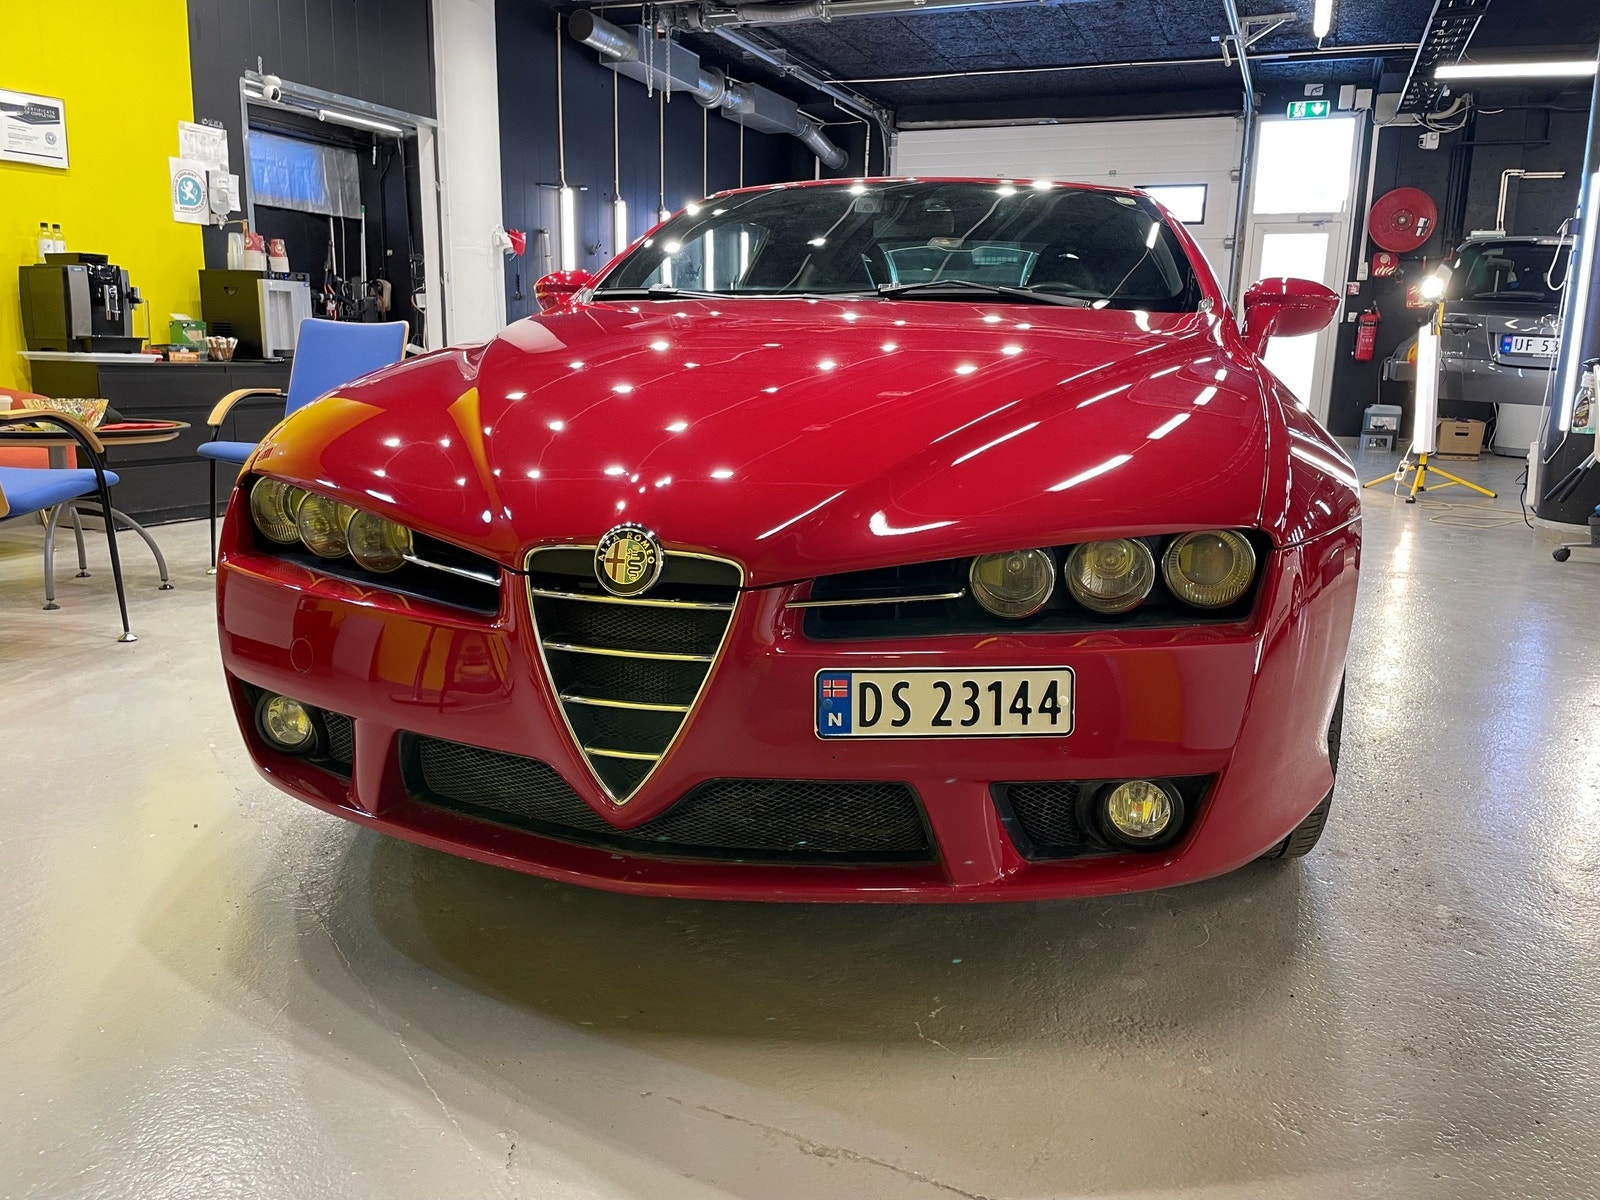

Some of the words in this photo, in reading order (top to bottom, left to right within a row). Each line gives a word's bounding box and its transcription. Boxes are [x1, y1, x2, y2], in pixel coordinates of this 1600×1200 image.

[1514, 338, 1533, 351] UF
[598, 534, 620, 562] ALFA
[626, 531, 656, 565] ROMEO
[858, 681, 912, 728] DS
[930, 680, 1062, 728] 23144
[827, 712, 842, 727] N
